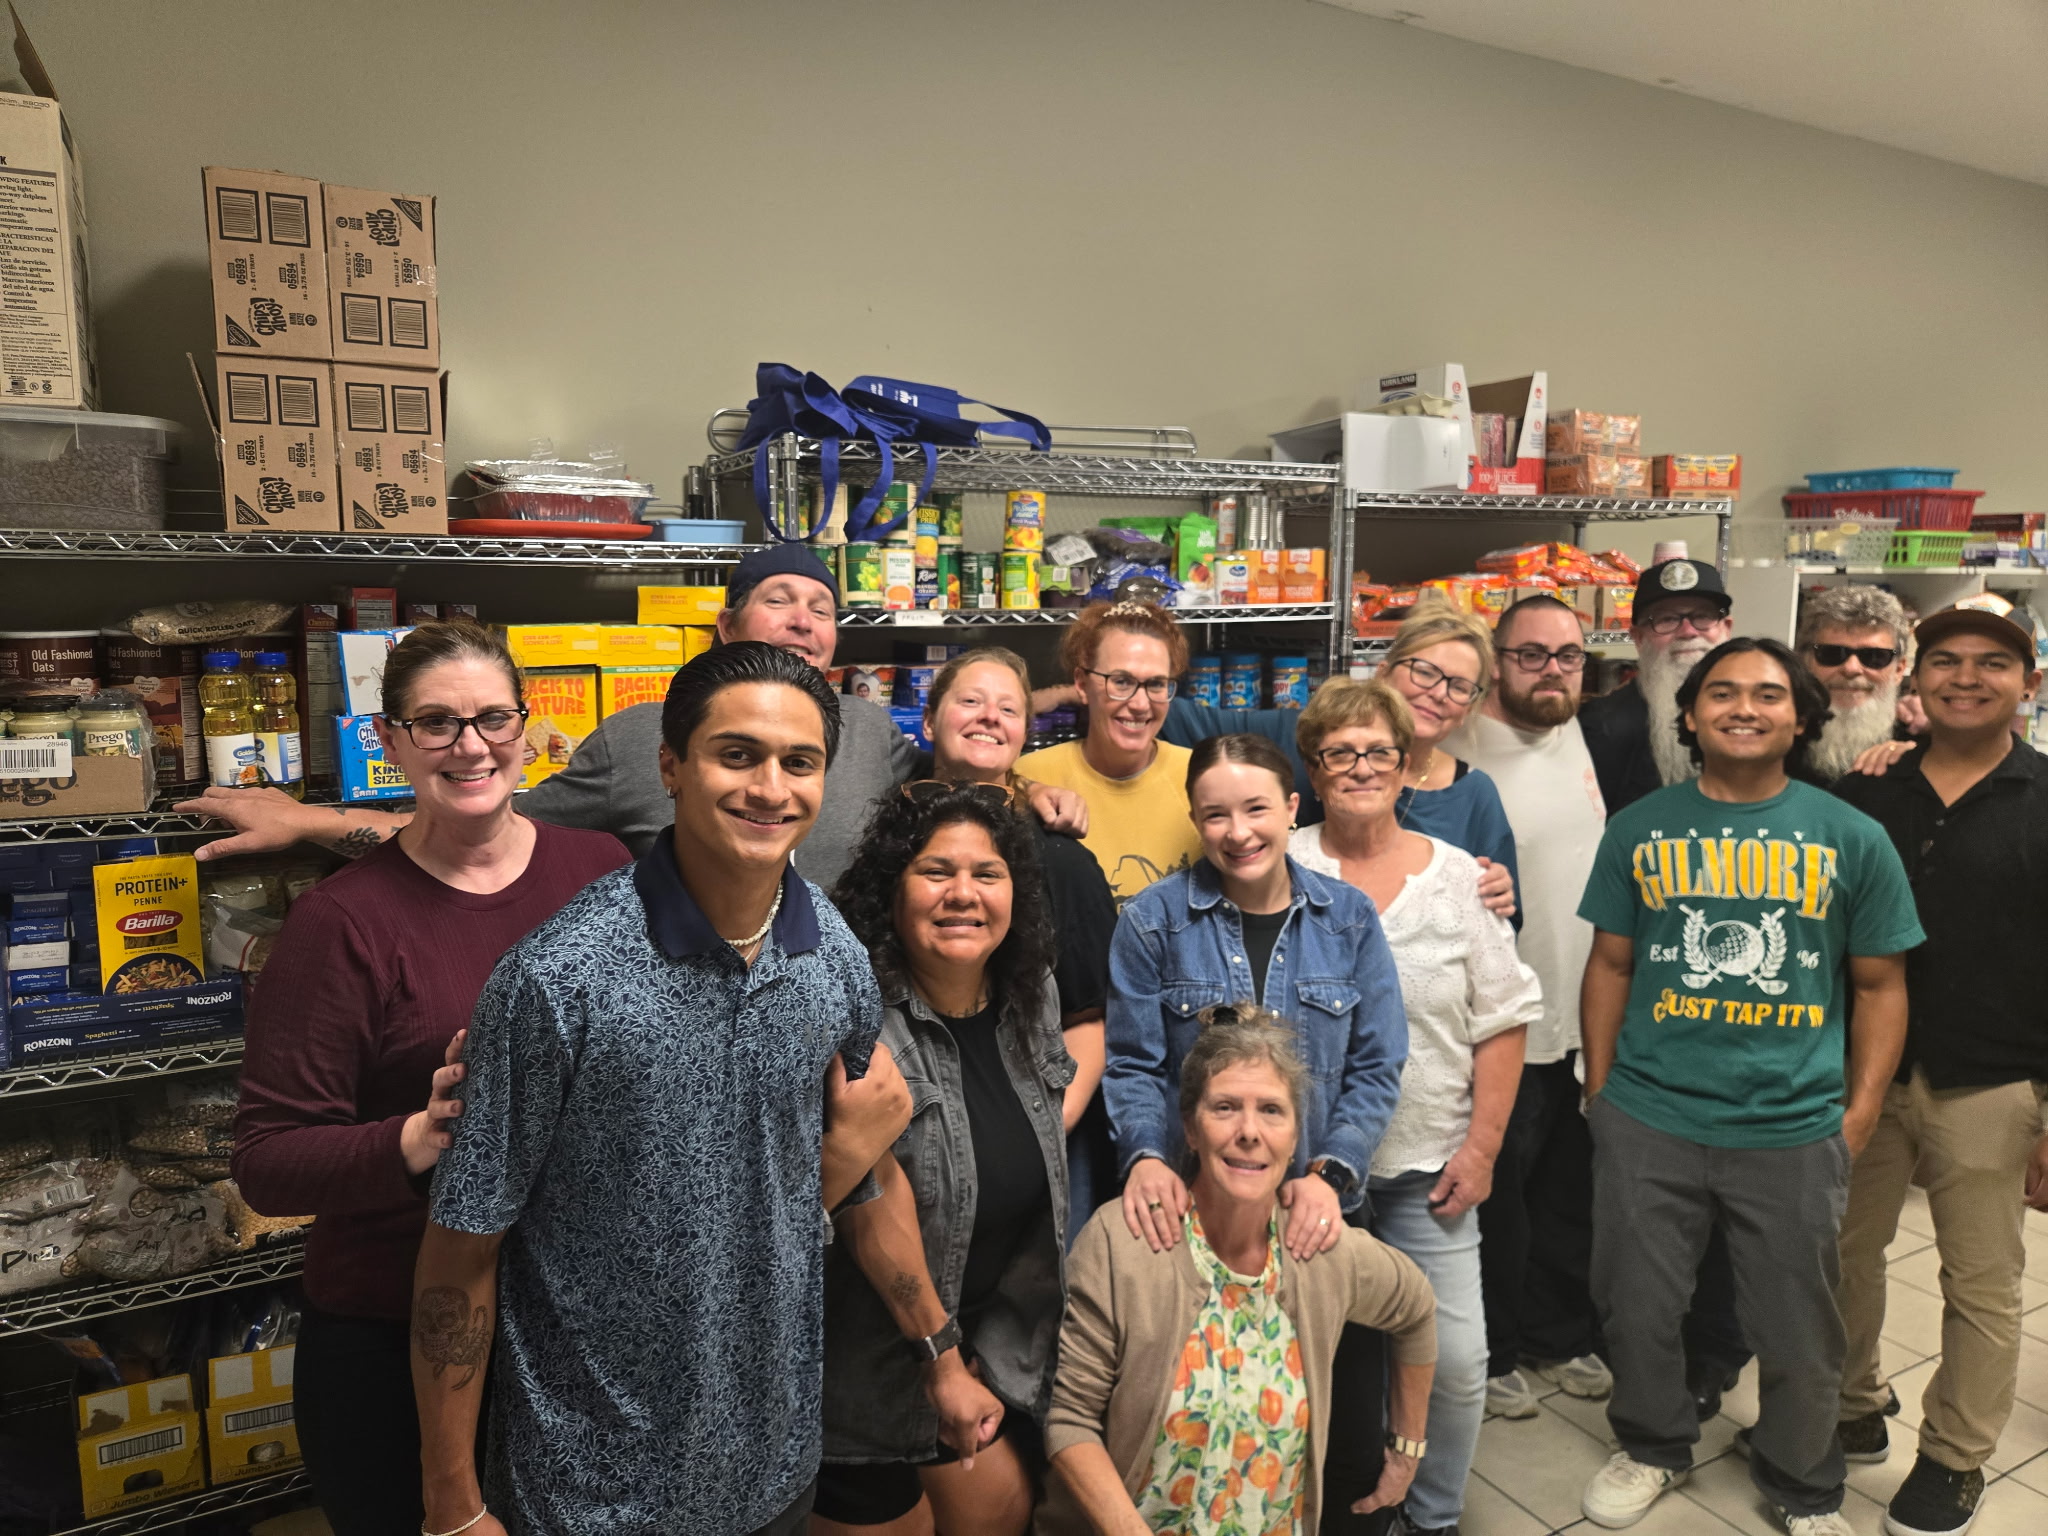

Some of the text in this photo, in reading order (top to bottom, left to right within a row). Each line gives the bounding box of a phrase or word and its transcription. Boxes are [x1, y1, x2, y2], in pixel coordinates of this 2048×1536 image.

[21, 178, 54, 187] FEATURES
[366, 212, 395, 246] Ahoy!
[377, 209, 397, 241] Chips
[235, 258, 246, 285] 05693
[286, 263, 297, 289] 05694
[355, 252, 365, 278] 05694
[403, 258, 413, 283] 05693
[254, 304, 276, 336] Chips
[255, 298, 287, 332] Ahoy!
[1380, 375, 1416, 387] KIRKLAND
[245, 440, 256, 465] 05693
[295, 443, 306, 468] 05694
[362, 448, 372, 472] 05693
[409, 449, 419, 474] 05694
[262, 483, 284, 513] Chips
[263, 477, 295, 509] Ahoy!
[379, 489, 398, 518] Chips
[380, 483, 409, 514] Ahoy!
[236, 620, 256, 628] OATS
[32, 648, 161, 660] Old Fashioned Fashioned
[33, 662, 55, 672] Oats
[567, 678, 586, 696] TO
[614, 676, 656, 698] BACK
[528, 696, 586, 716] ATURE
[88, 732, 123, 745] Prego
[359, 727, 377, 741] Chi
[115, 877, 188, 896] PROTEIN+
[1633, 838, 1837, 921] GILMORE
[134, 896, 163, 906] PENNE
[124, 914, 175, 930] Barilla
[1649, 944, 1679, 962] Est
[143, 992, 232, 1012] RONZONI Spaghetti
[1722, 1000, 1773, 1026] TAP
[1777, 1004, 1805, 1027] IT
[23, 1029, 118, 1052] RONZONI Spaghetti
[12, 1262, 57, 1278] BEANS
[234, 1464, 272, 1476] Jumbo
[111, 1480, 200, 1509] Jumbo Wieners
